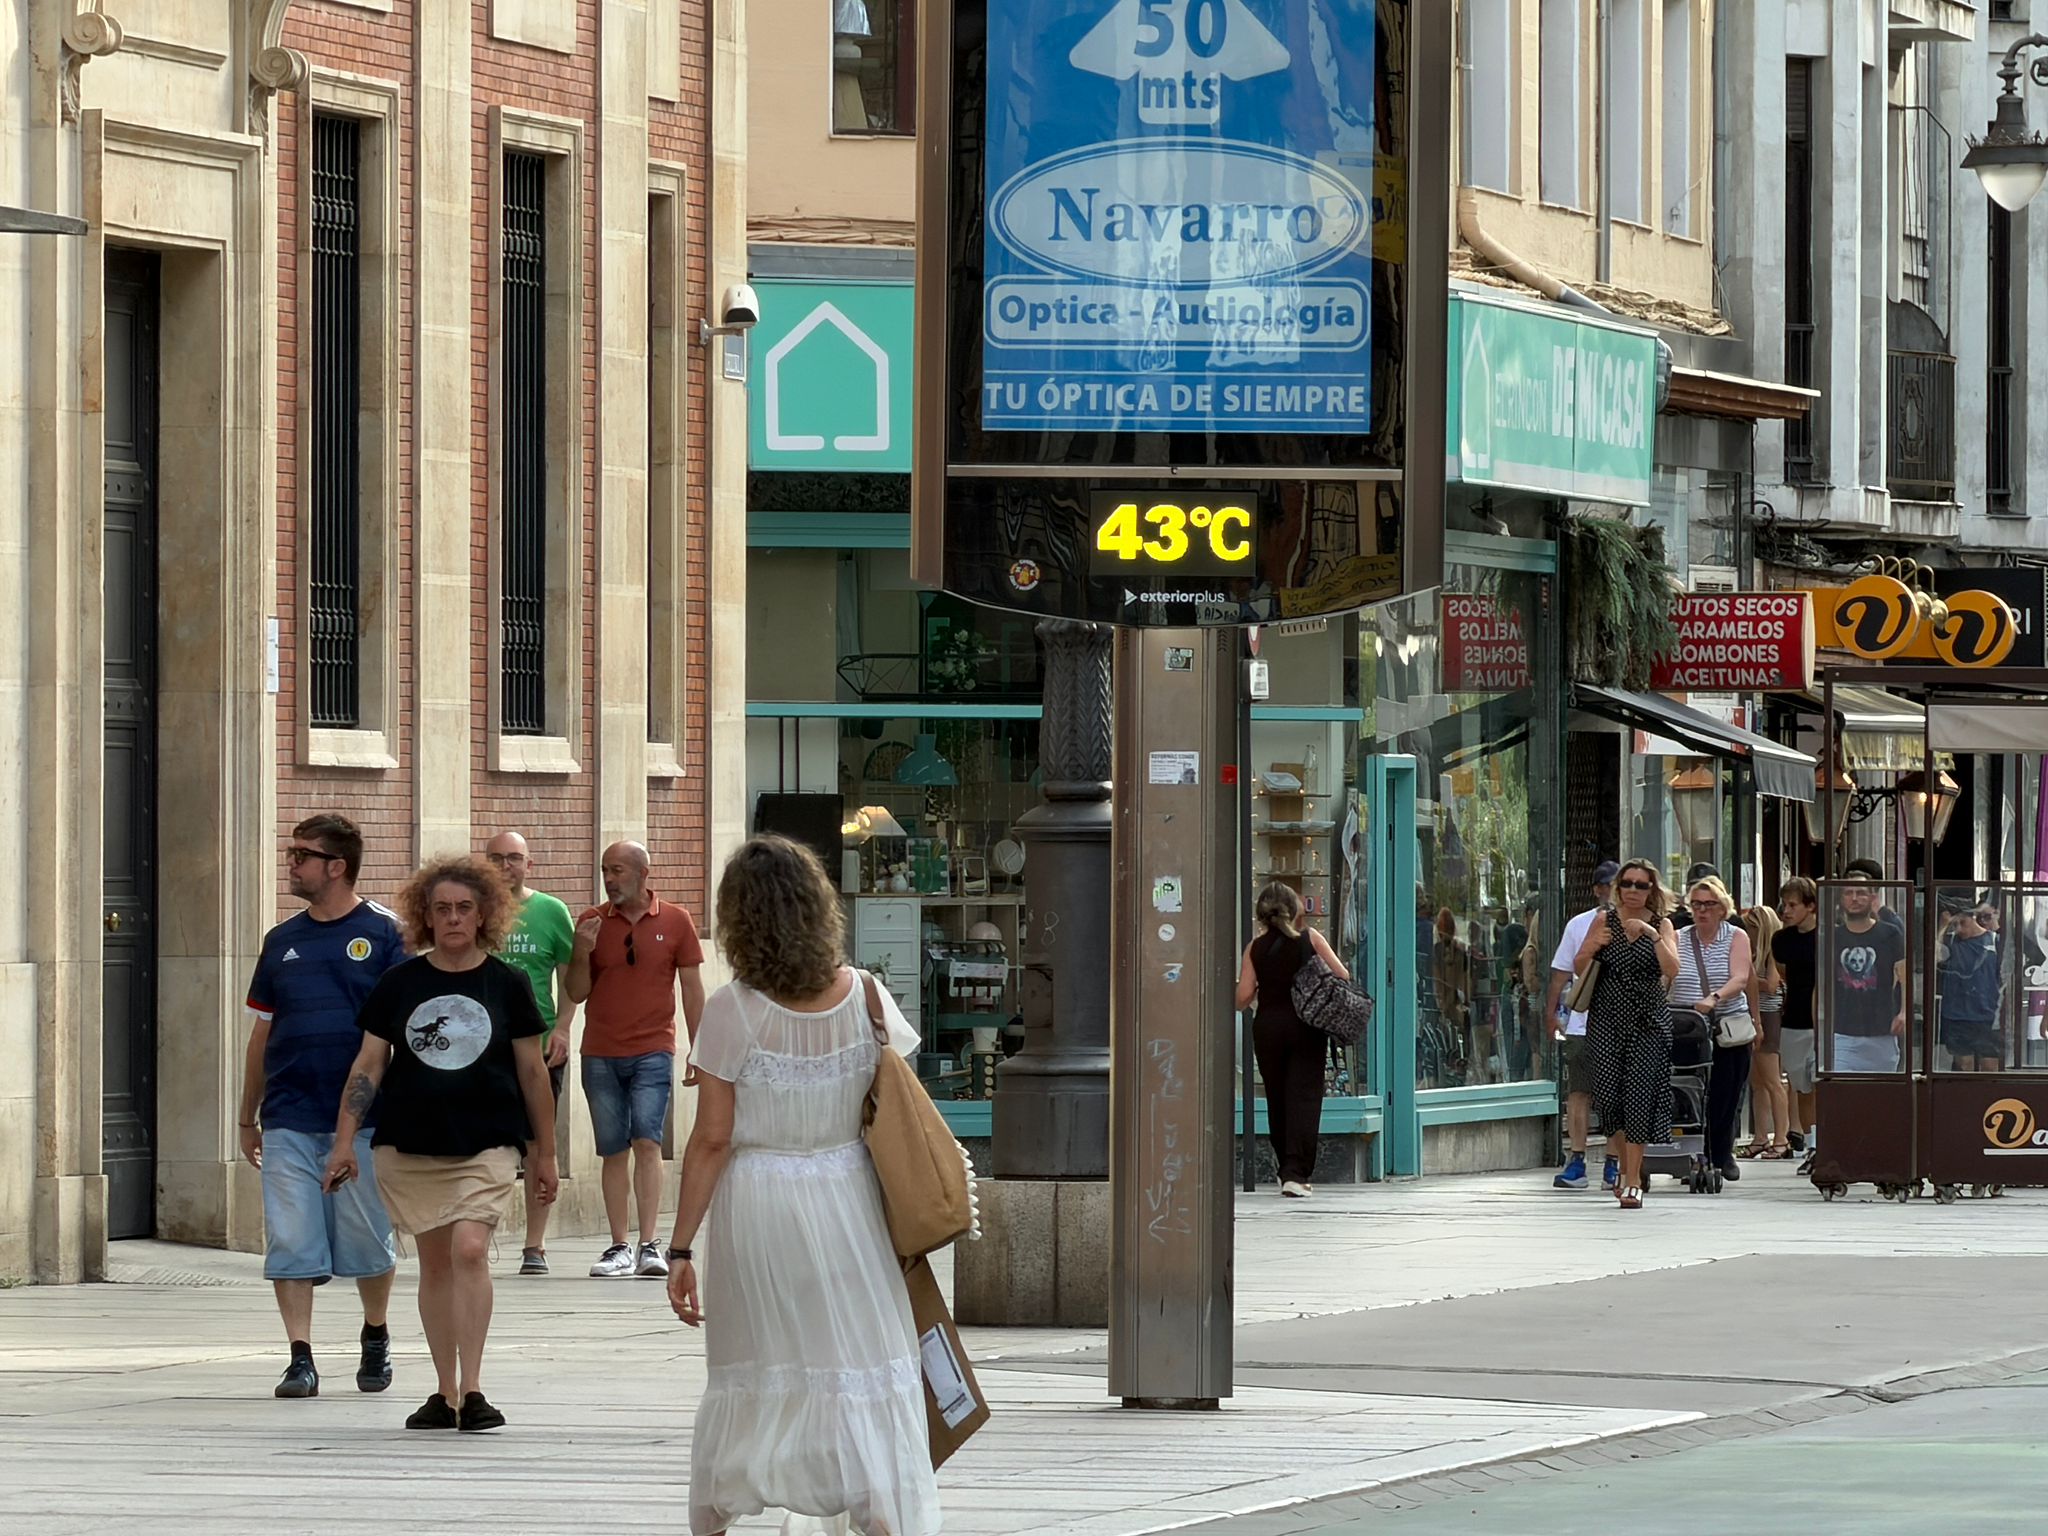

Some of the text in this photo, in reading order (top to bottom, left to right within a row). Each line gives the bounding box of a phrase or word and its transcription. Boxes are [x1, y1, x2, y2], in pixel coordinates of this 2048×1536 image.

[1133, 0, 1227, 58] 50
[1142, 71, 1219, 110] mts
[1048, 188, 1325, 243] Navarro
[999, 295, 1120, 331] Optica
[1152, 296, 1355, 334] Audiología
[984, 378, 1365, 414] TU ÓPTICA DE SIEMPRE
[1552, 344, 1575, 438] DE
[1577, 348, 1598, 442] MI
[1601, 353, 1645, 449] CASA
[1140, 590, 1225, 606] exteriorplus
[1667, 598, 1798, 616] RUTOS SECOS
[2010, 607, 2031, 635] RI
[1672, 667, 1782, 686] ACEITUNAS
